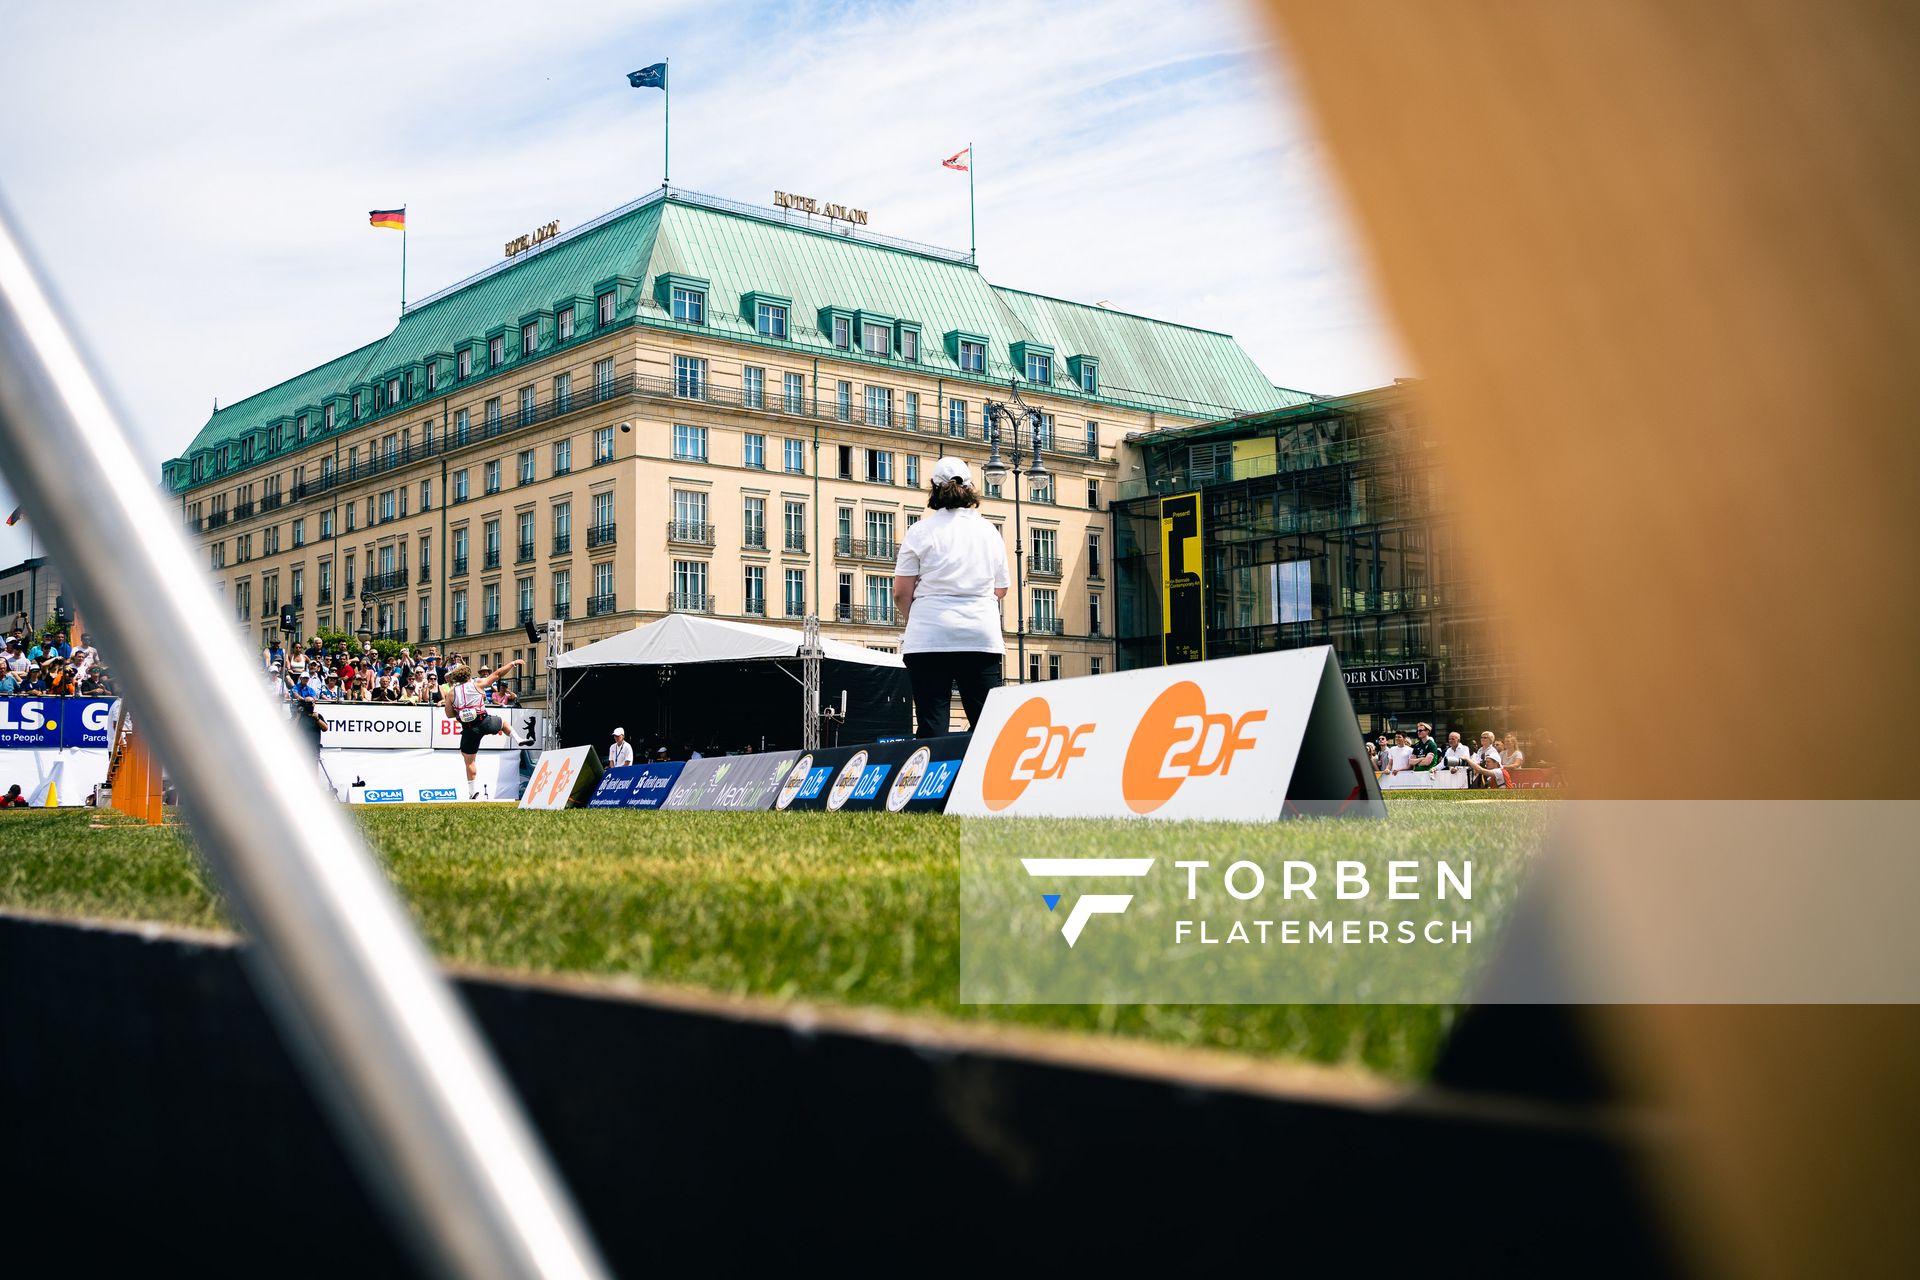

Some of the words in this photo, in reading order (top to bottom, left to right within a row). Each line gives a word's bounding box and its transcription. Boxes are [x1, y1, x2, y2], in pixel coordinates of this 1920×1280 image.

[773, 190, 820, 214] HOTEL
[822, 202, 869, 225] ADLON
[1343, 671, 1367, 684] DER
[1370, 667, 1420, 682] KÜNSTE
[13, 733, 44, 743] People
